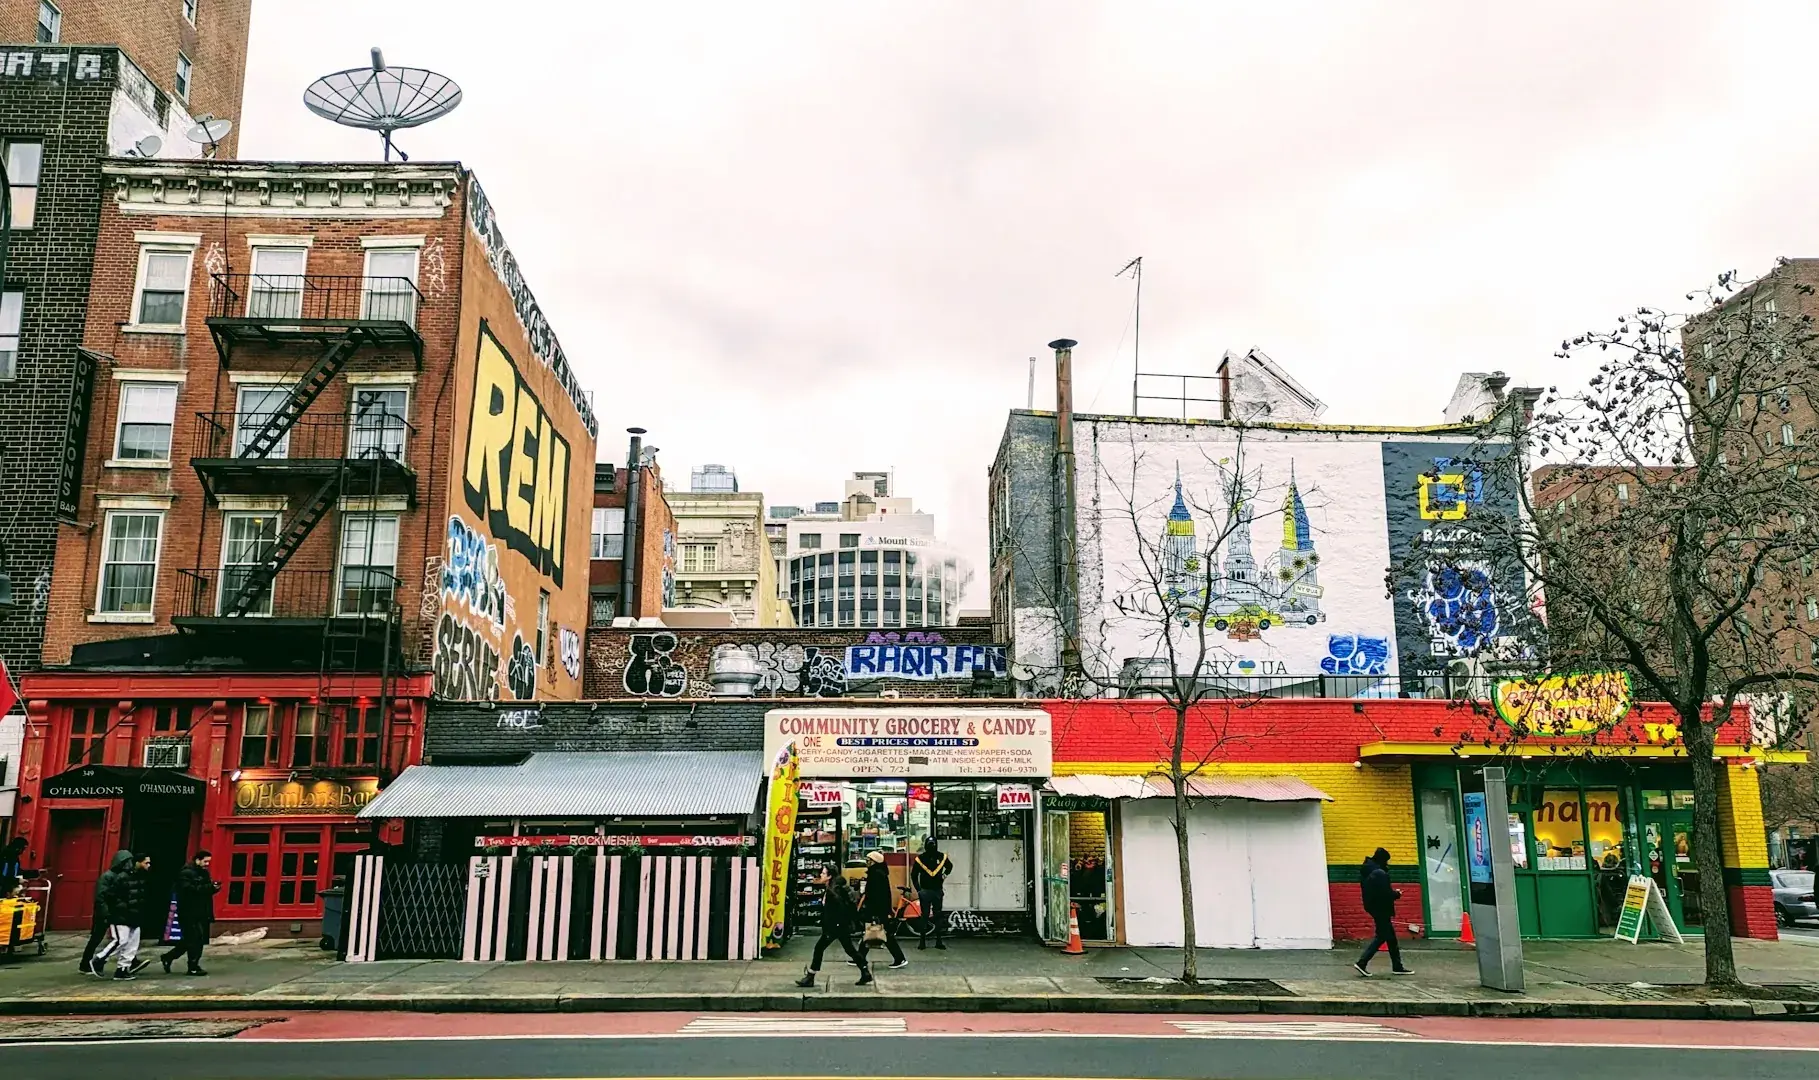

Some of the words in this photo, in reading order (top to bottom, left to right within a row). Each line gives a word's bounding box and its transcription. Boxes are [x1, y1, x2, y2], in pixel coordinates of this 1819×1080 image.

[464, 318, 570, 589] REM
[59, 500, 77, 514] BAR
[878, 536, 908, 546] Mount
[1204, 660, 1235, 676] NY
[1260, 660, 1289, 676] UA
[779, 717, 881, 736] COMMUNITY
[885, 718, 961, 736] GROCERY
[966, 721, 977, 736] &
[982, 717, 1037, 736] CANDY
[803, 736, 822, 748] ONE
[840, 738, 867, 746] BEST
[872, 738, 909, 746] PRICES
[913, 738, 929, 746] ON
[934, 738, 958, 746] 14TH
[962, 738, 976, 746] ST
[813, 756, 841, 764] CARDS
[49, 786, 125, 796] O'HANLON'S
[139, 783, 182, 795] O'HANLON'S
[182, 784, 196, 795] BAR
[339, 785, 377, 808] Bar
[809, 791, 841, 802] ATM
[999, 792, 1031, 804] ATM
[1646, 828, 1654, 837] A
[569, 834, 642, 847] ROCKMEISHA
